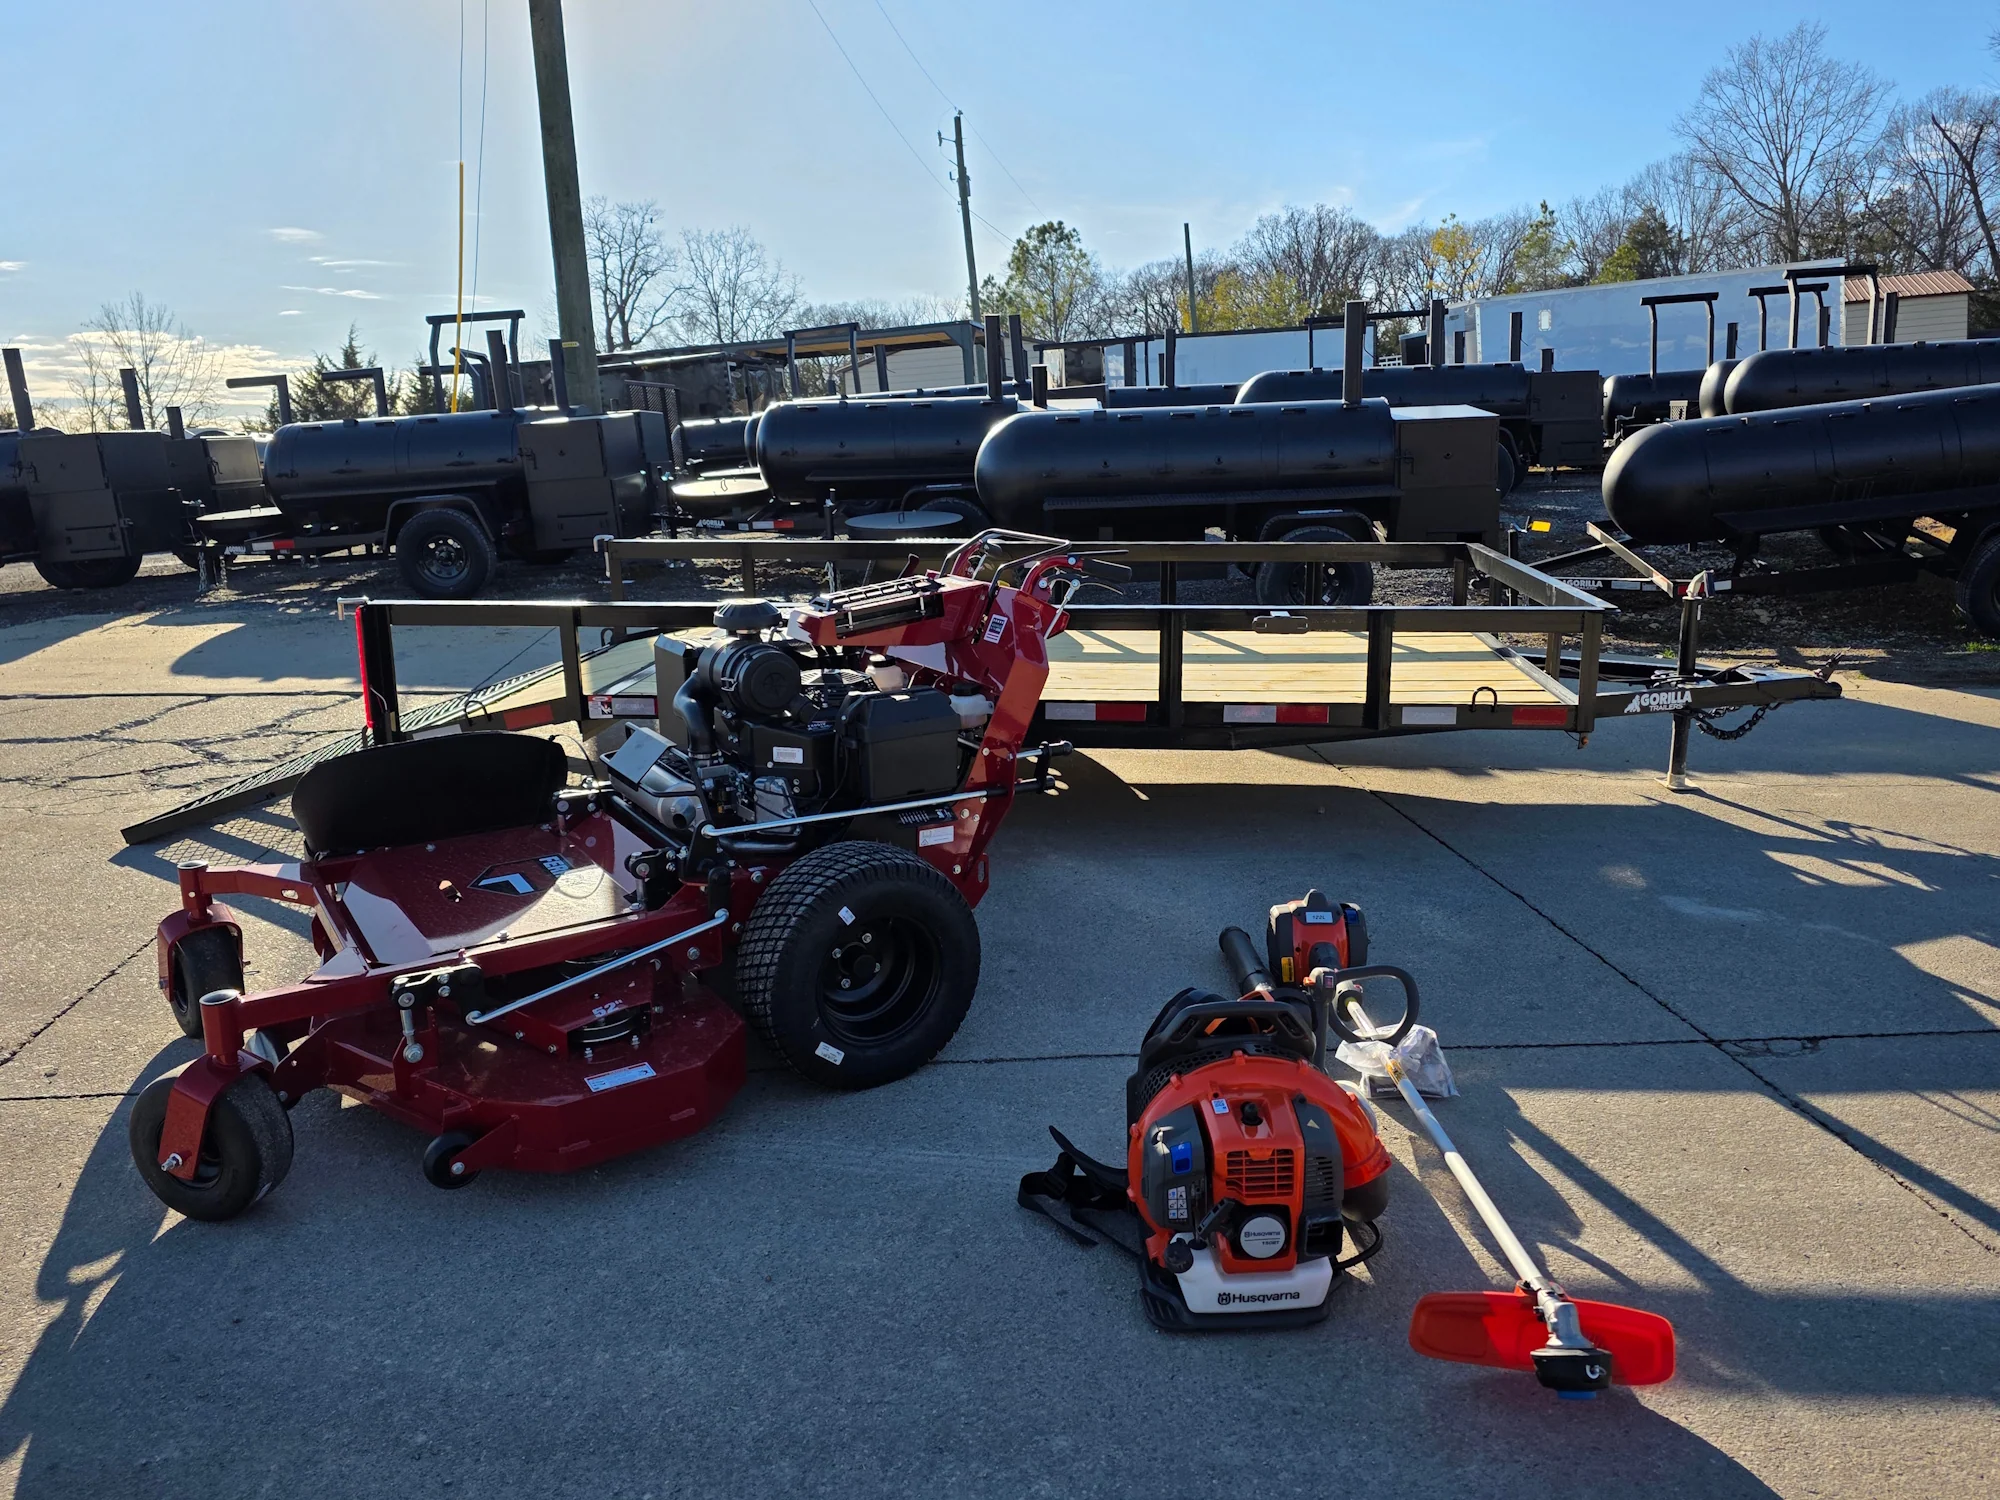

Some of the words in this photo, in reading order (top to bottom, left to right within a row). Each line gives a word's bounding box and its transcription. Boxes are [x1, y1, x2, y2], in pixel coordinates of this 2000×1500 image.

[1566, 580, 1603, 588] GORILLA
[1640, 690, 1693, 707] GORILLA
[1649, 703, 1684, 711] TRAILERS
[592, 999, 623, 1018] 52"
[1232, 1291, 1301, 1303] Husqvarna
